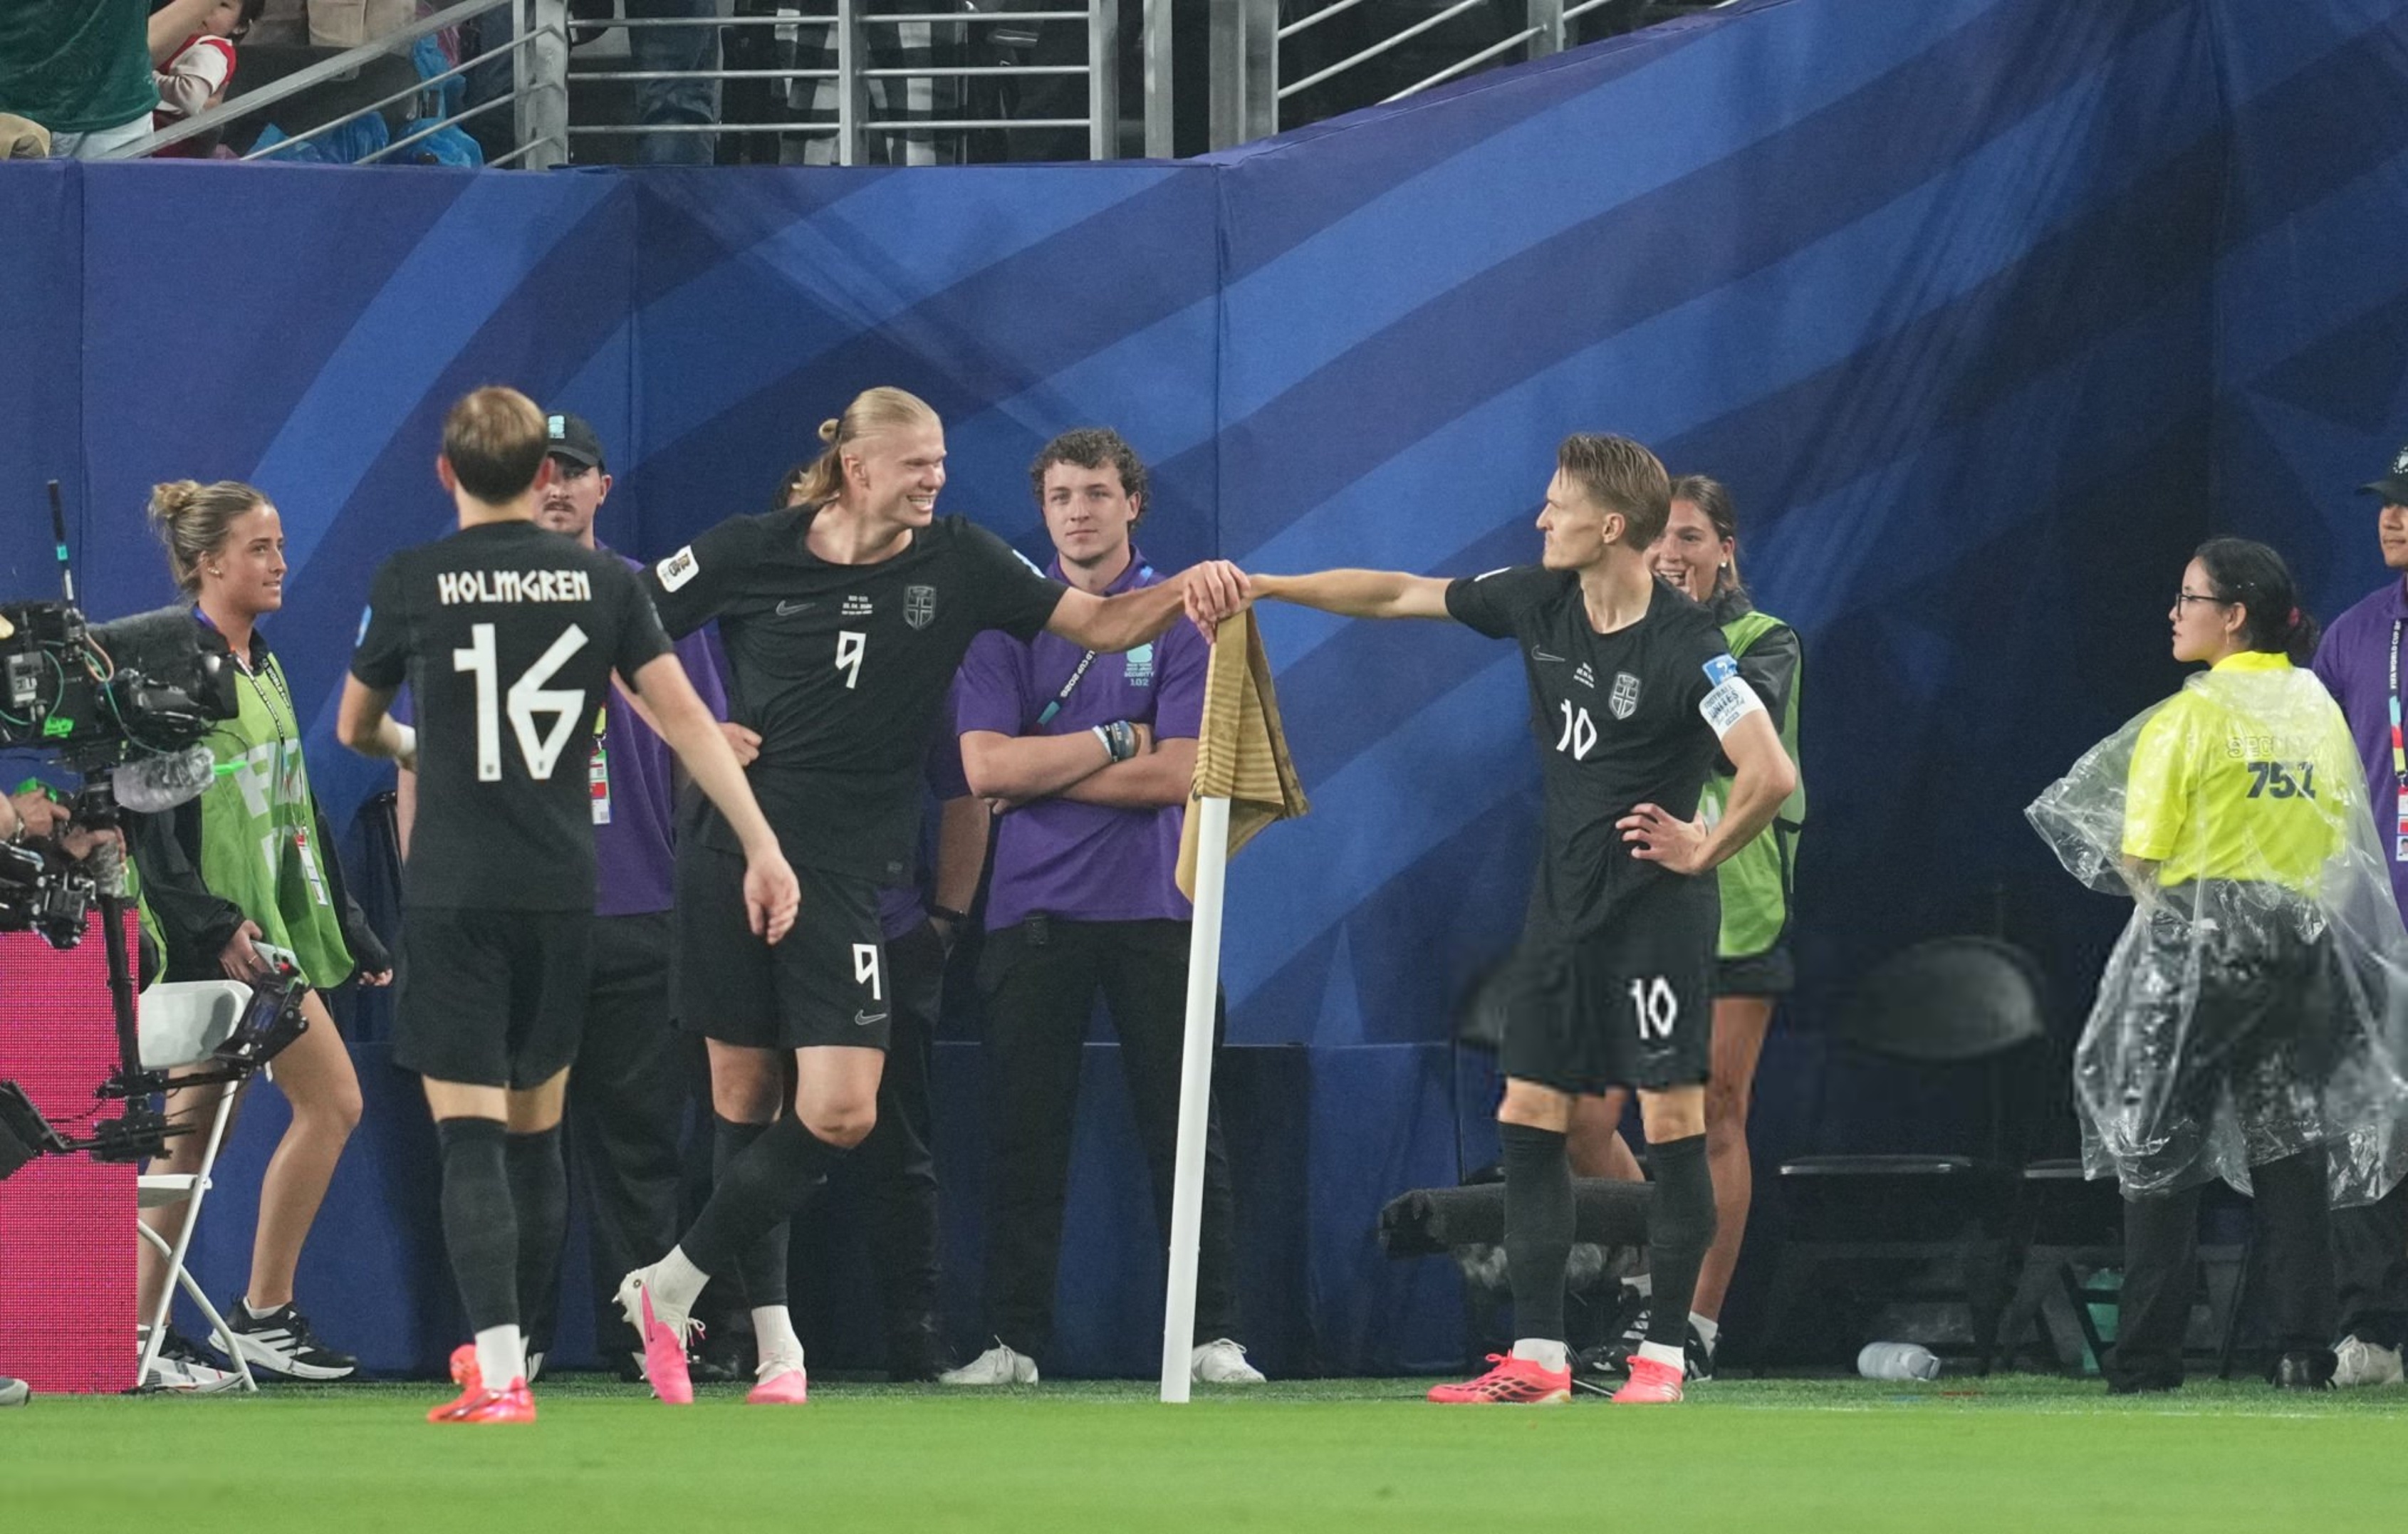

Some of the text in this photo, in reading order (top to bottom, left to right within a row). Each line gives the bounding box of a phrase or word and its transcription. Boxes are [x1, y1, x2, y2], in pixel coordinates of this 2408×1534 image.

[438, 570, 591, 605] HOLMGREN
[835, 630, 867, 689] 9
[1078, 659, 1089, 674] CUP
[453, 623, 589, 781] 16
[1555, 699, 1597, 761] 10
[853, 944, 881, 1000] 9
[1629, 975, 1678, 1040] 10
